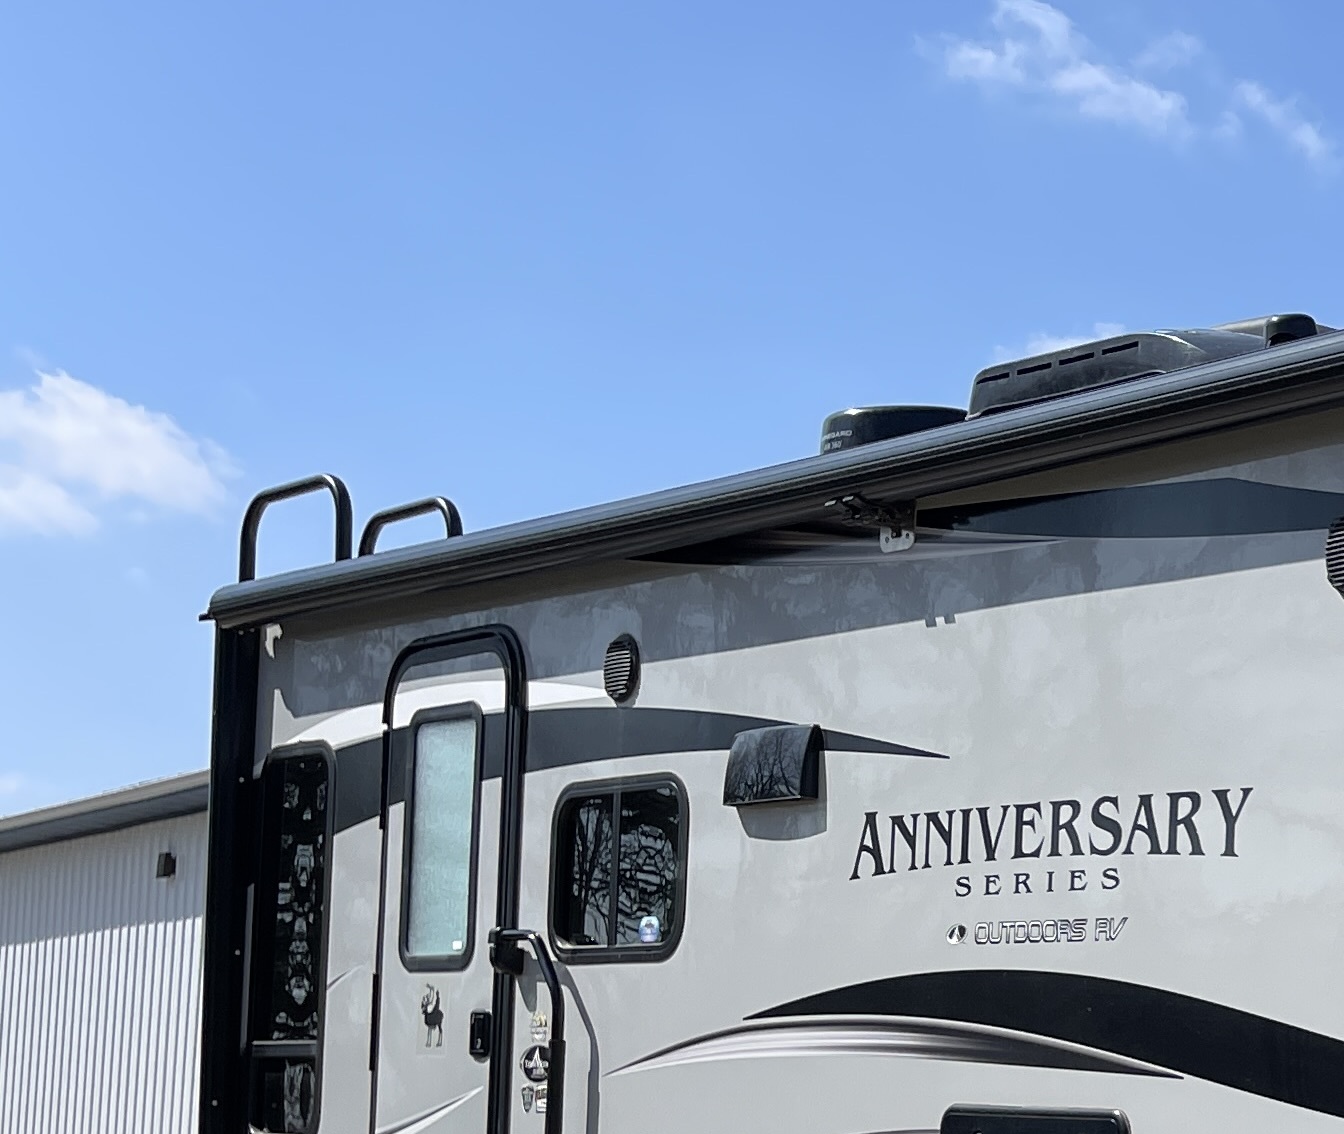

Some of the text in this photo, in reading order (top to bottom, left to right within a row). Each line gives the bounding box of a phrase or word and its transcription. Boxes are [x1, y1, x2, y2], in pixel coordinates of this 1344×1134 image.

[849, 787, 1254, 881] ANNIVERSARY
[954, 867, 1121, 897] SERIES
[974, 917, 1128, 945] OUTDOORS RV
